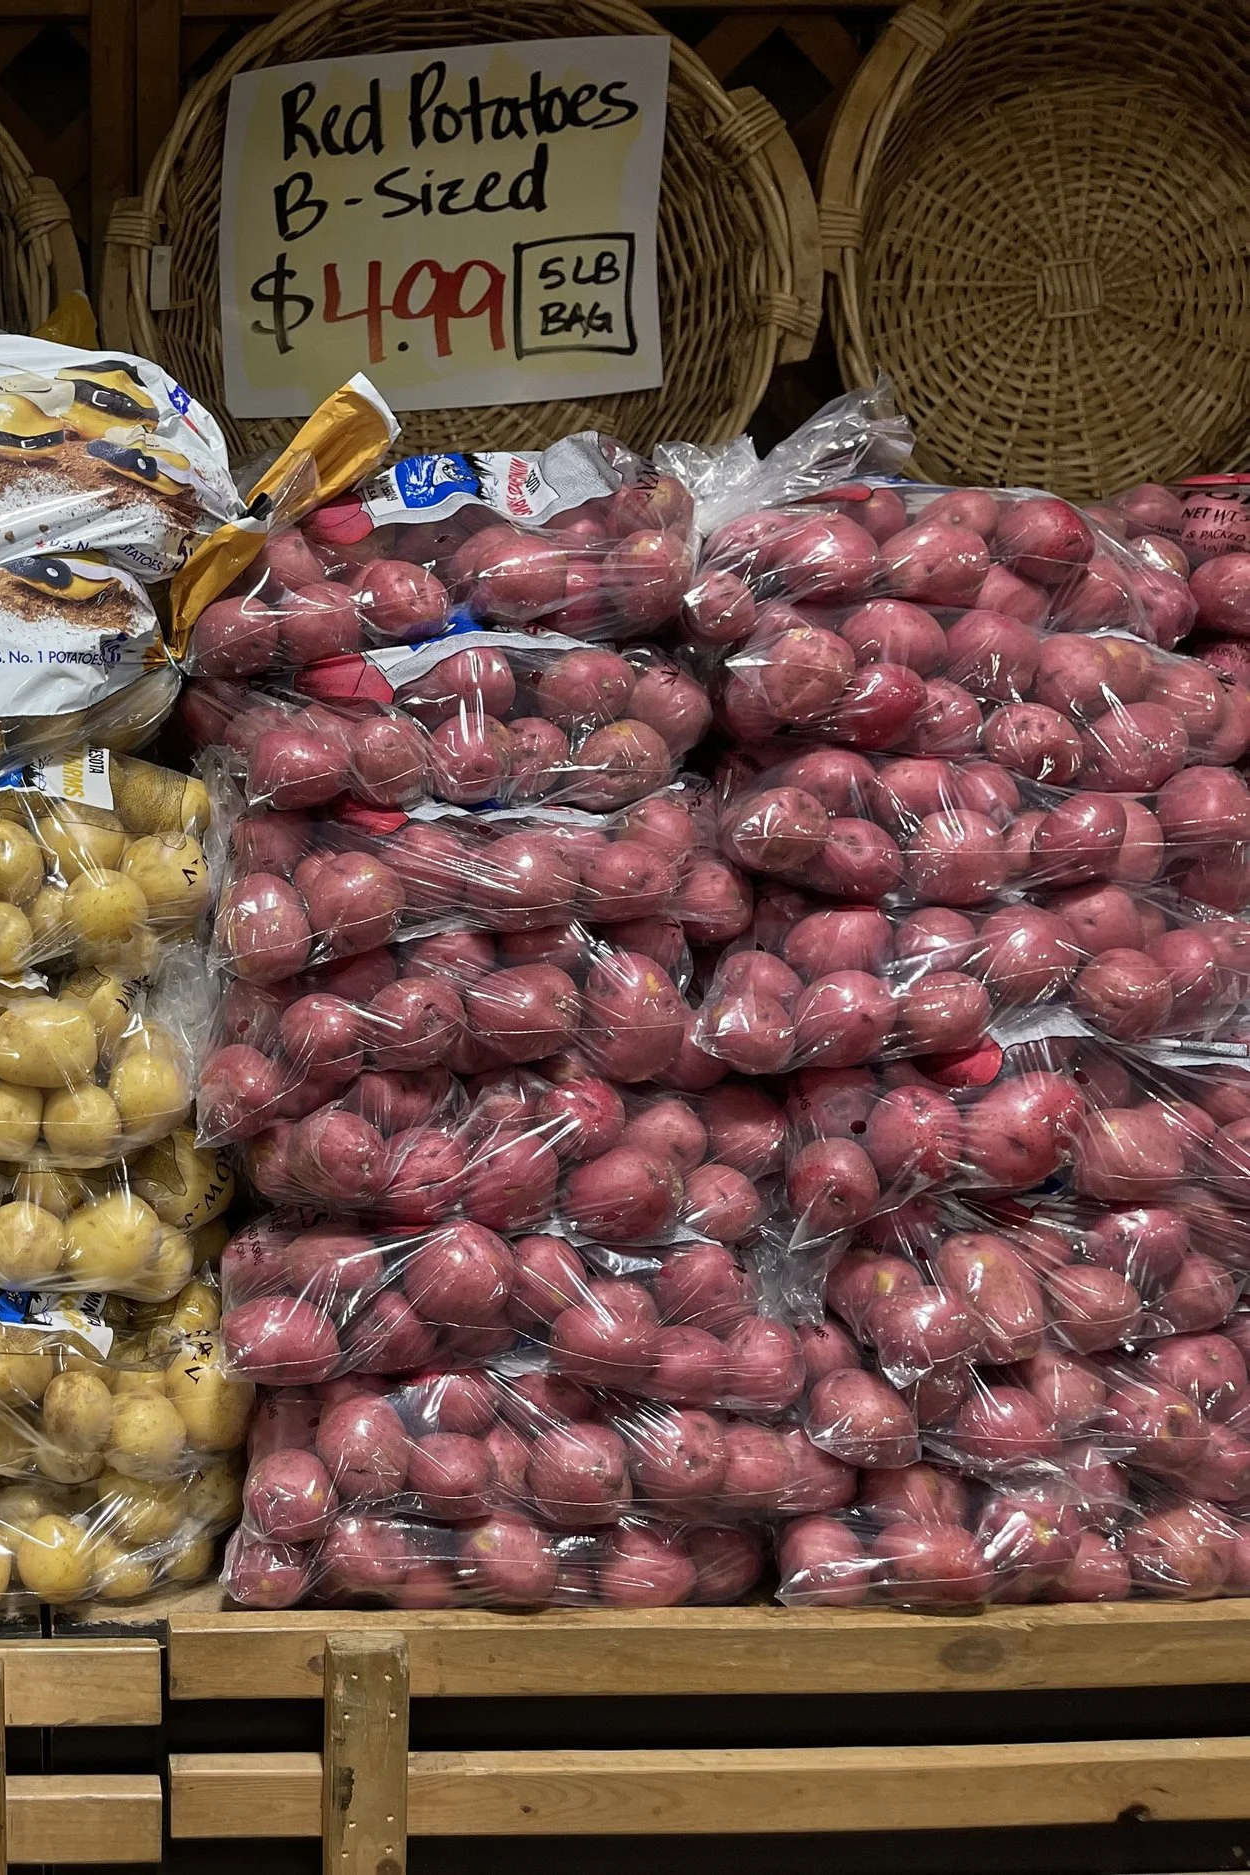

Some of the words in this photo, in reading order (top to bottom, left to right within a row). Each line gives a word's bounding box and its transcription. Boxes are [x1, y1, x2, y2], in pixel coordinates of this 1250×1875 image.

[282, 79, 383, 160] Red
[410, 61, 638, 149] Potatoes
[540, 303, 612, 337] BAG
[1182, 507, 1211, 519] NET
[1213, 509, 1240, 525] WT
[117, 544, 163, 571] TATOES
[9, 650, 33, 664] No.
[37, 651, 43, 663] 1
[49, 651, 104, 666] POTATOES
[89, 745, 105, 775] ESOTA
[62, 753, 85, 798] FARMS
